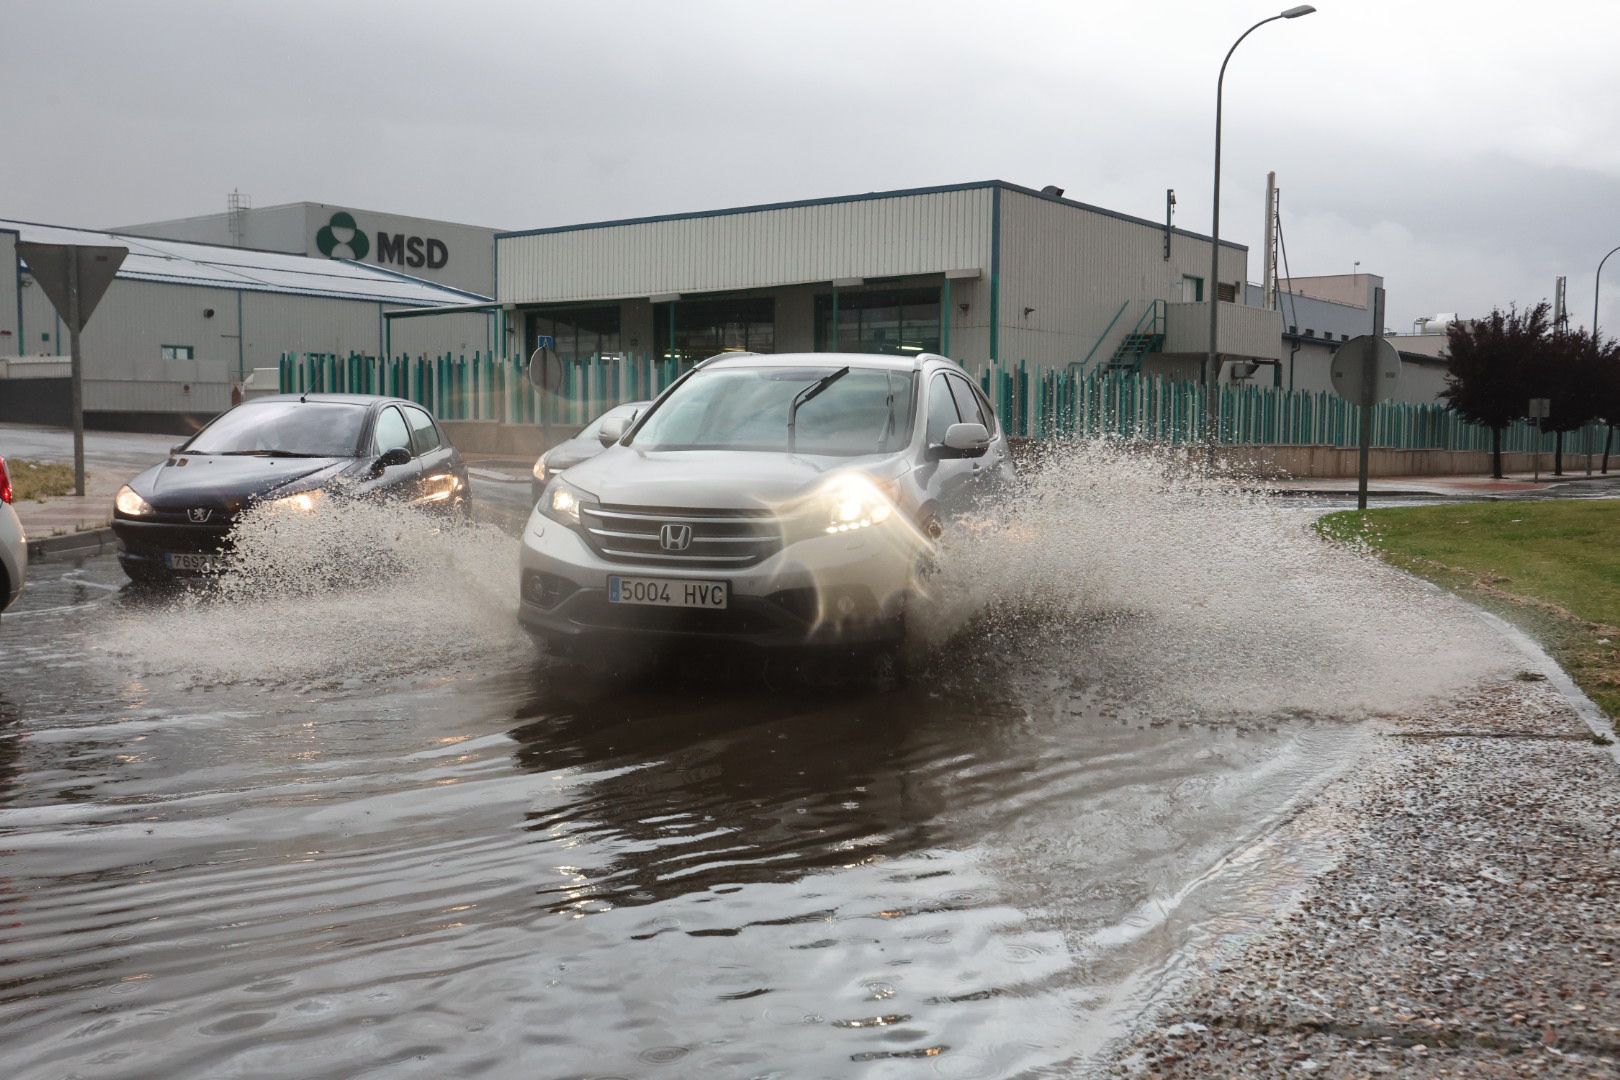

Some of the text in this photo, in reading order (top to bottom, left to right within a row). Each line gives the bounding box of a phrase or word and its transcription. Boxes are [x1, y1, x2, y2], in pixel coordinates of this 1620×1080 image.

[377, 231, 449, 269] MSD
[621, 581, 723, 605] 5004 HVC
